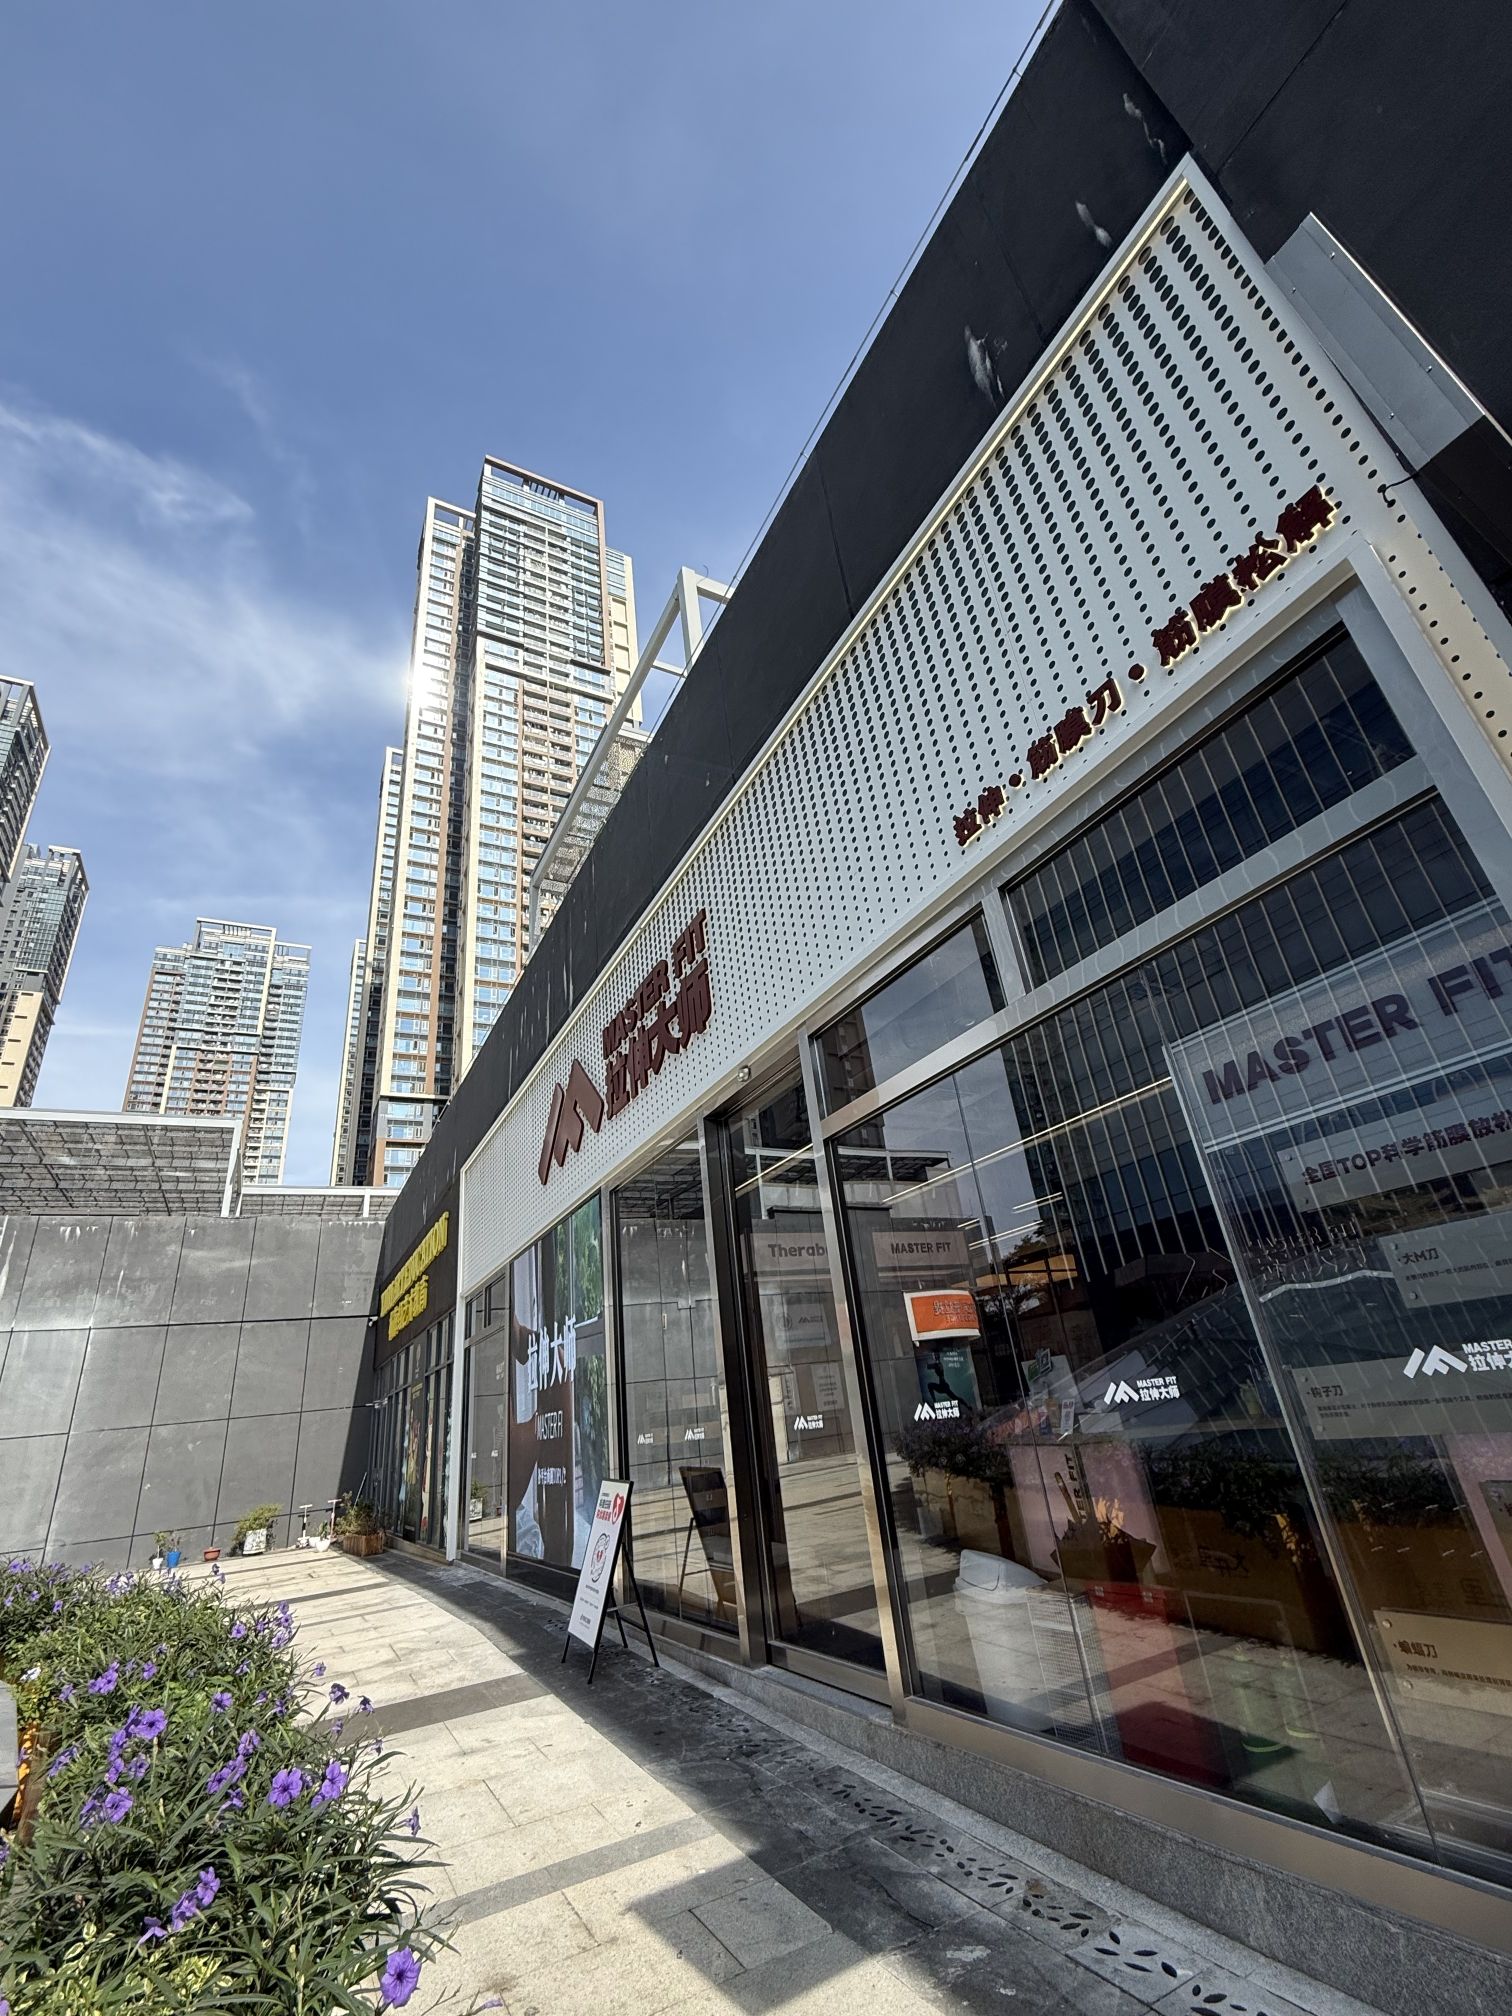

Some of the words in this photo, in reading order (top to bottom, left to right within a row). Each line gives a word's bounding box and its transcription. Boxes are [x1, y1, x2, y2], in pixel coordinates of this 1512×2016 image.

[602, 959, 671, 1061] MASTER
[671, 908, 708, 980] FIT
[605, 957, 713, 1121] 拉伸大师
[1201, 993, 1420, 1106] MASTER
[768, 1242, 830, 1260] Therab
[890, 1243, 934, 1255] MASTER
[935, 1241, 952, 1253] FIT
[527, 1313, 577, 1394] 拉伸大师
[1462, 1338, 1512, 1354] MASTER
[1136, 1377, 1164, 1389] MASTER
[1164, 1375, 1178, 1386] FIT
[1140, 1386, 1180, 1403] 拉伸大师
[536, 1412, 558, 1440] MASTER
